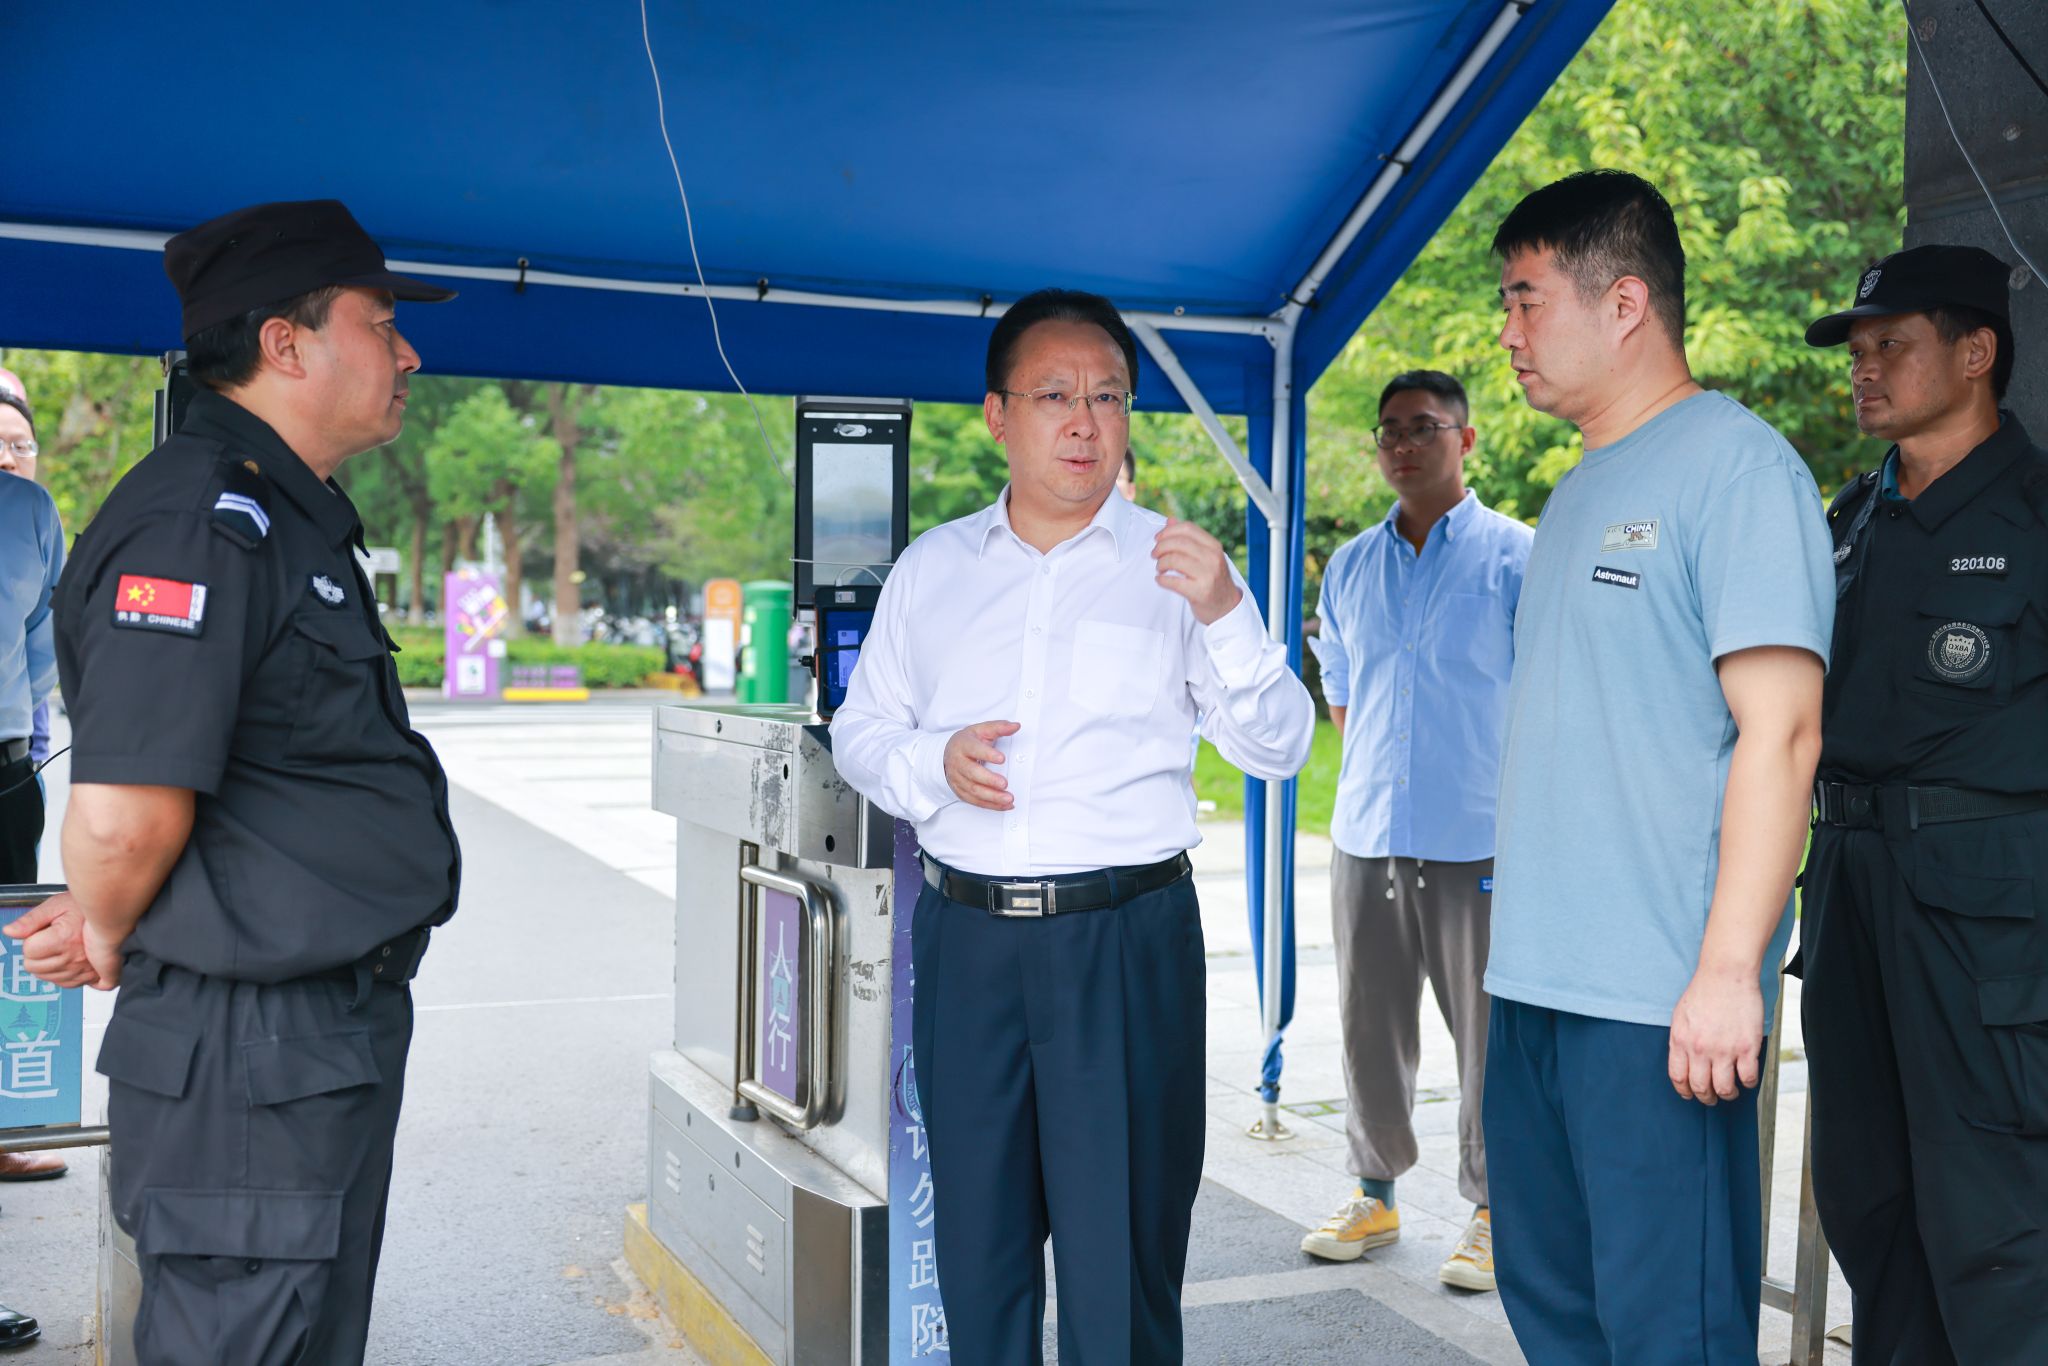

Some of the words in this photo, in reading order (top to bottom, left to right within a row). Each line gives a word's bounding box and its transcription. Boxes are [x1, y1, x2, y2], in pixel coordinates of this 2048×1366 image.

[1625, 523, 1653, 533] CHINA
[1951, 556, 2006, 571] 320106
[1594, 568, 1637, 586] Astronaut
[148, 614, 195, 629] CHINESE
[768, 920, 793, 1073] 人行
[0, 938, 61, 1099] 通道
